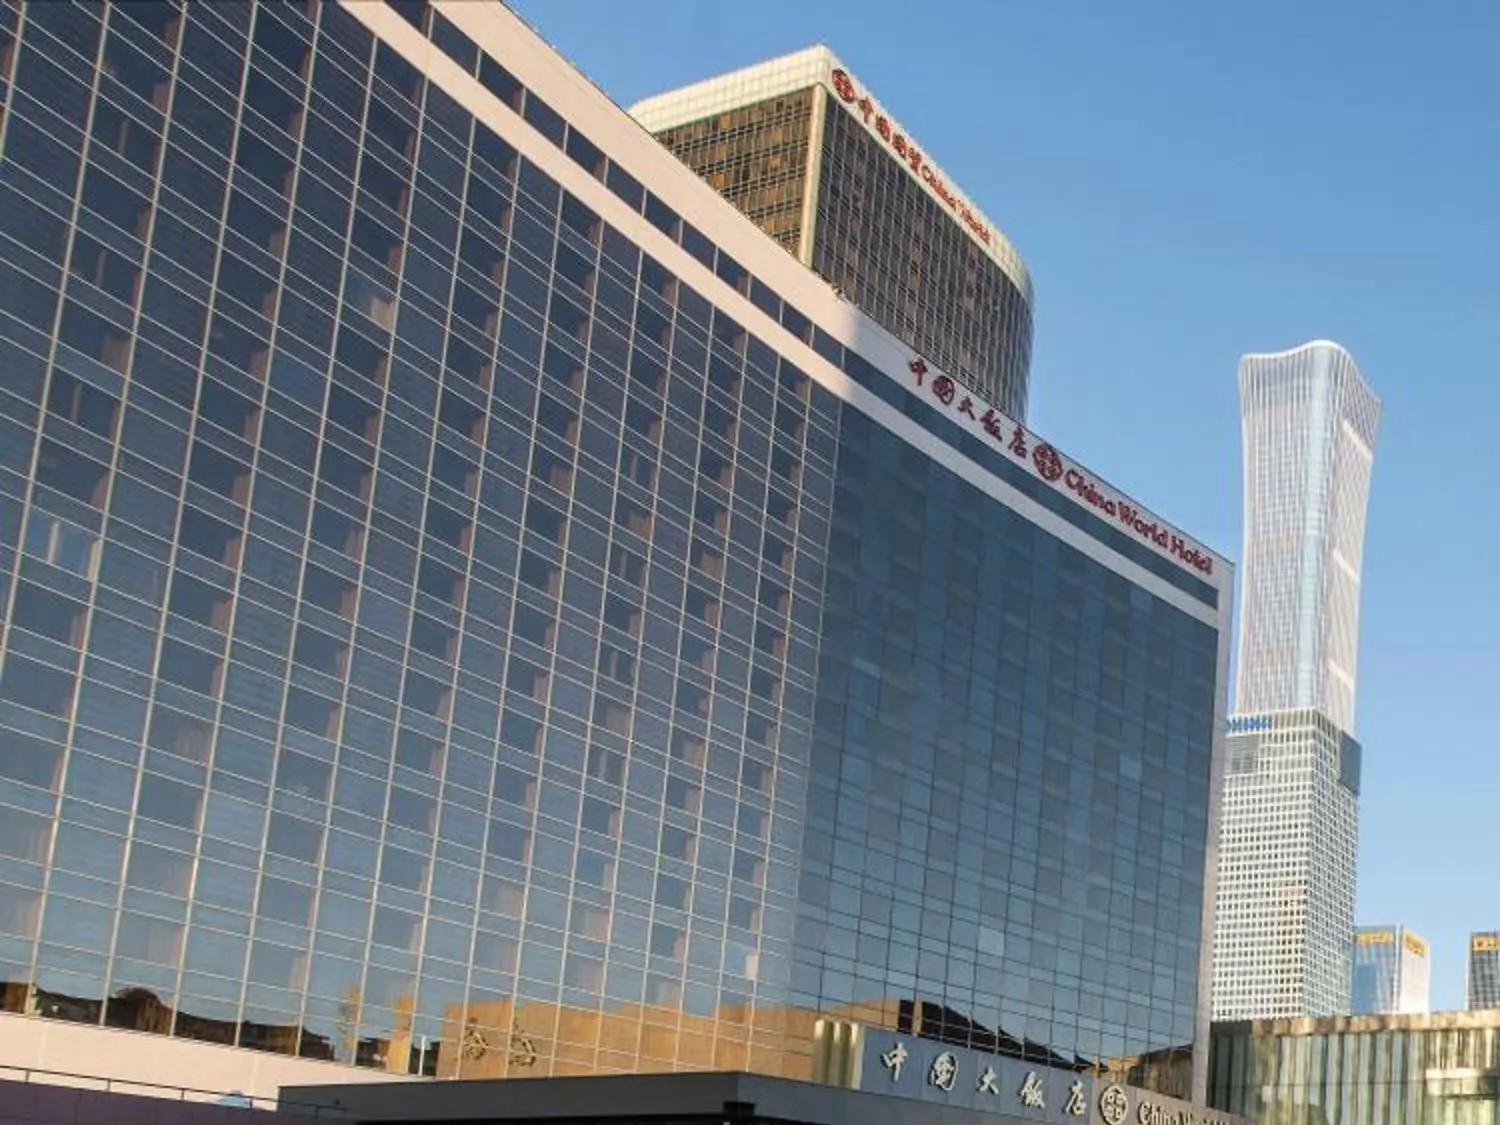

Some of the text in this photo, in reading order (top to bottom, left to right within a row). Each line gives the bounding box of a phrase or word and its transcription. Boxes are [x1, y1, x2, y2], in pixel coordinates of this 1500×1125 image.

[1065, 469, 1213, 575] China World Hotel
